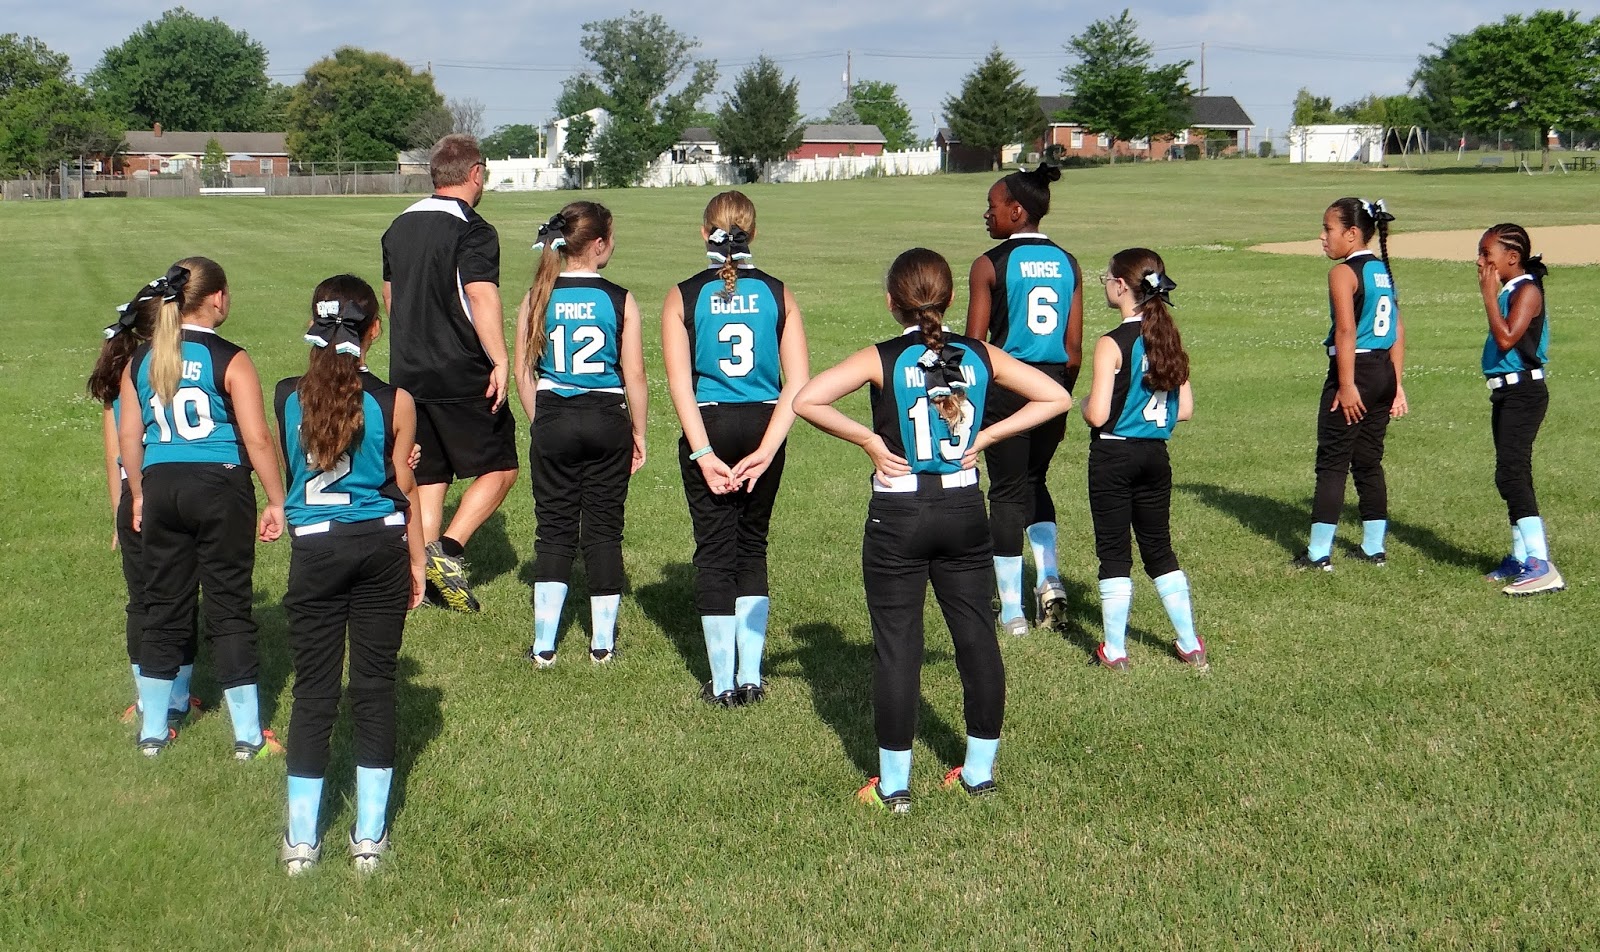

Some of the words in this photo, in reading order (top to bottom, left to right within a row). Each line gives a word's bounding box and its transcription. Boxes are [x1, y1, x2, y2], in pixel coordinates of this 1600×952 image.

[1019, 261, 1063, 278] MORSE
[555, 302, 597, 320] PRICE
[1026, 285, 1060, 336] 6
[1373, 295, 1391, 337] 8
[548, 323, 608, 375] 12
[717, 322, 756, 378] 3
[149, 385, 216, 443] 10
[908, 397, 976, 461] 13
[1141, 389, 1169, 429] 4
[305, 451, 353, 507] 2
